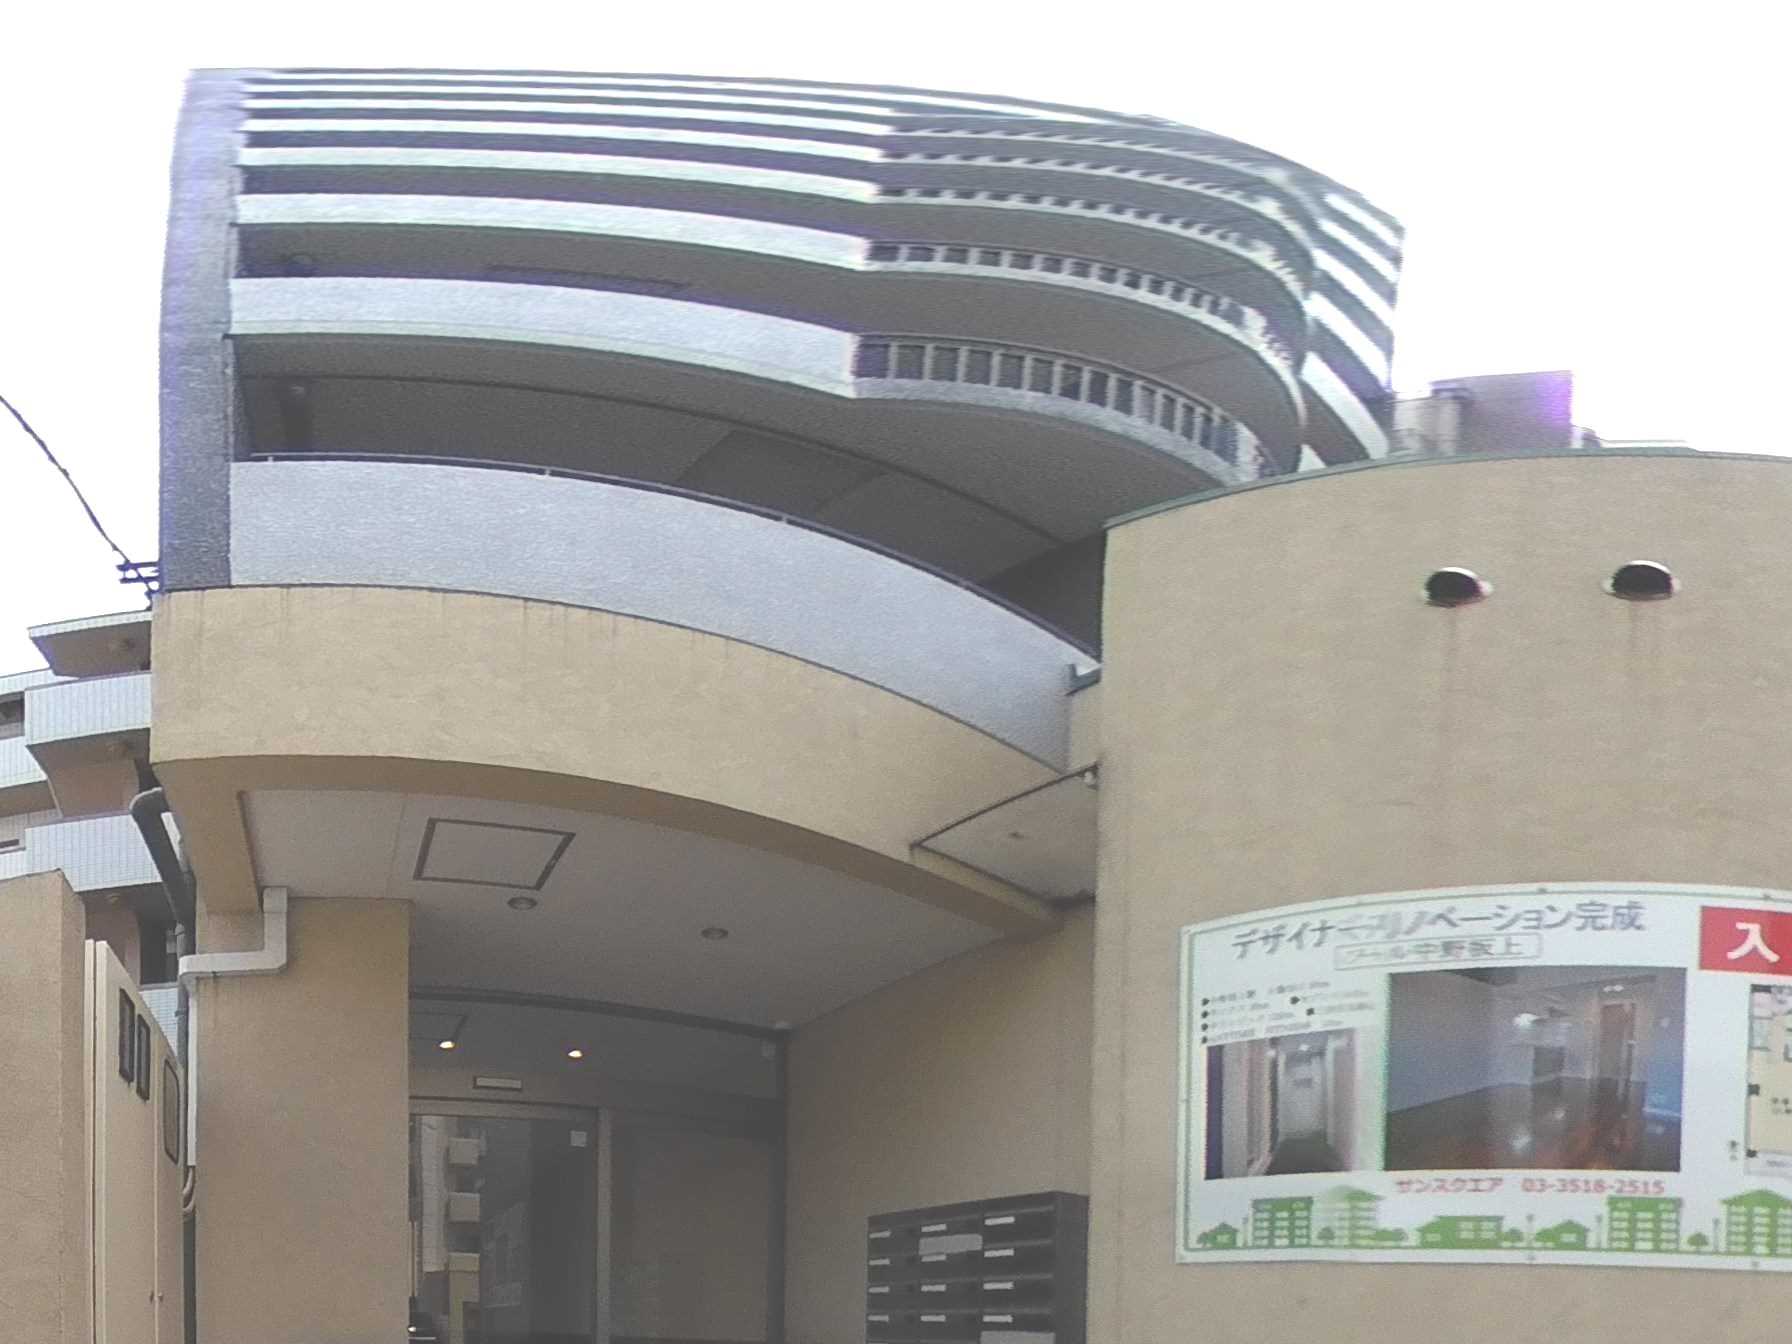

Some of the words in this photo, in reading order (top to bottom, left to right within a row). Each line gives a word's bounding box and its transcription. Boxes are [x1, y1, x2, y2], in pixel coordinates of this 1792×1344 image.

[1395, 1178, 1503, 1194] サンスクエア
